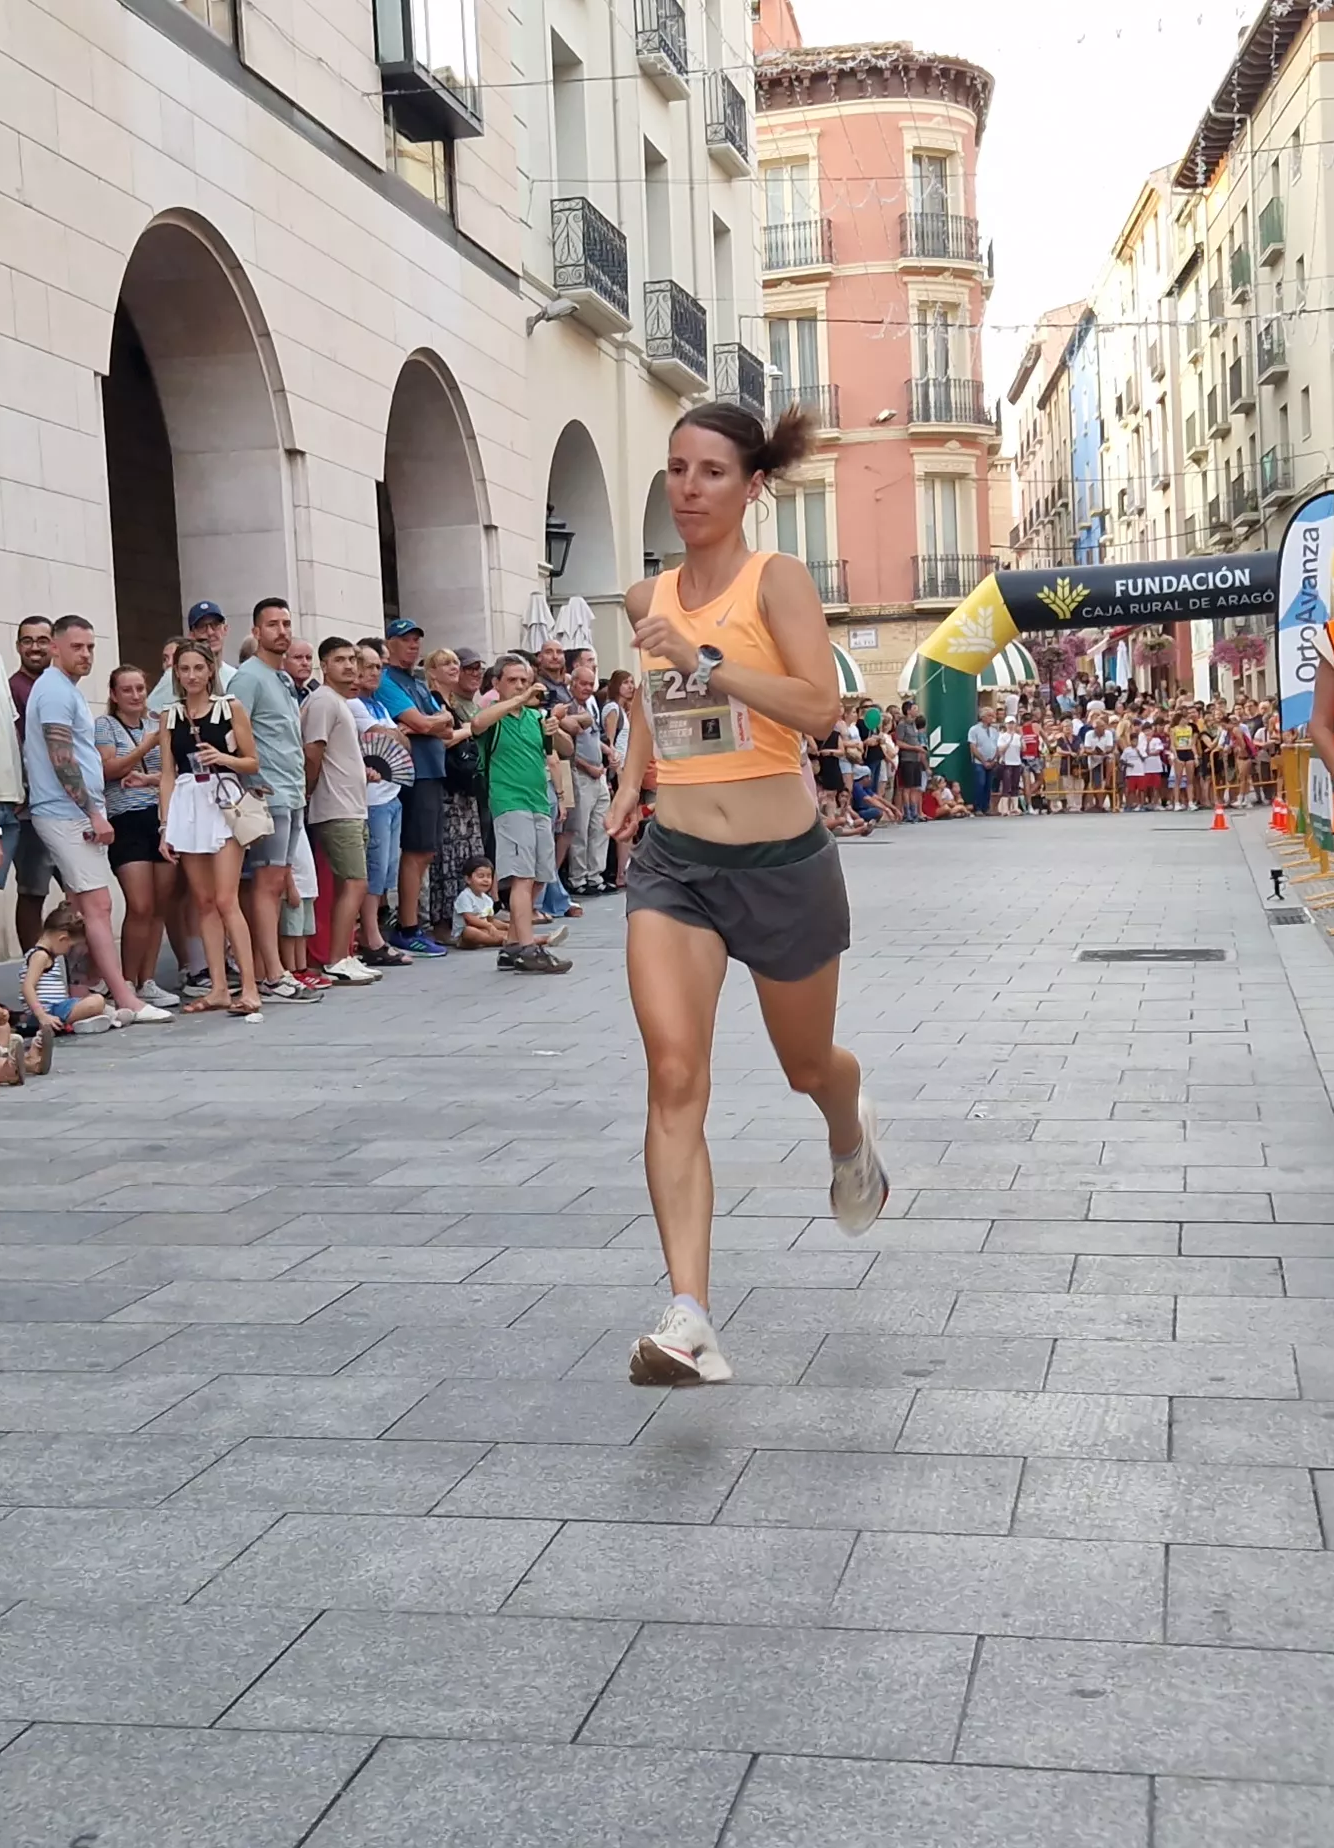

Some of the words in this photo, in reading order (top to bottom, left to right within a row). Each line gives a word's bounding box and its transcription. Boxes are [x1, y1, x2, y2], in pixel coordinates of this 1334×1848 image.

[1114, 565, 1252, 598] FUNDACIÓN
[1081, 603, 1124, 619] CAJA
[1129, 597, 1184, 614] RURAL
[1188, 596, 1212, 611] DE
[1217, 588, 1276, 607] ARAGÓ
[1295, 526, 1320, 684] OrtoAvanza
